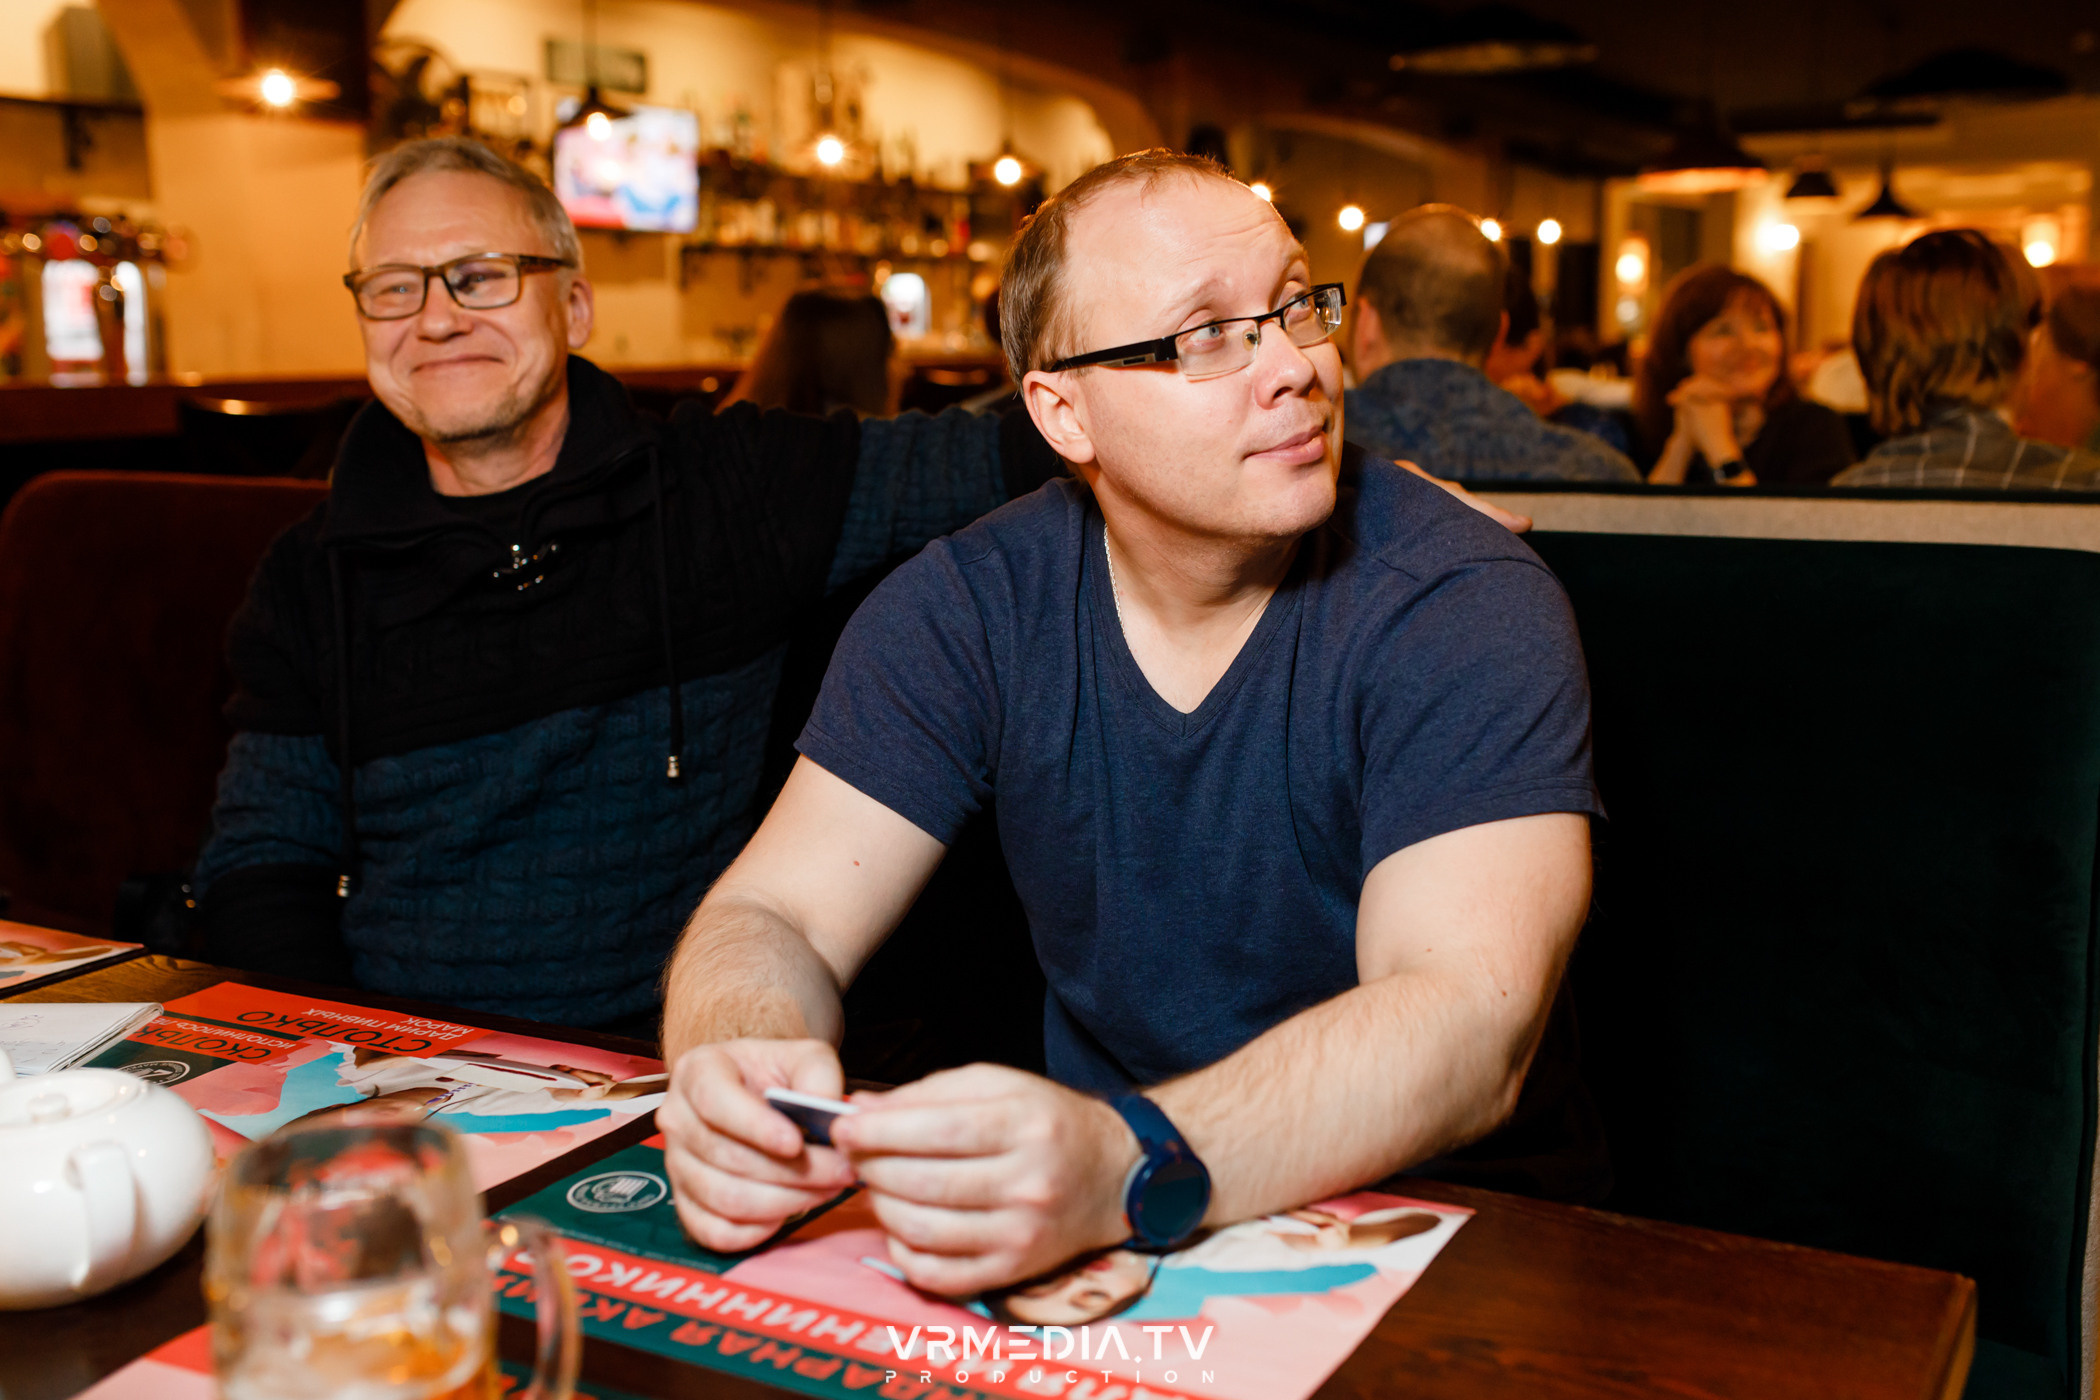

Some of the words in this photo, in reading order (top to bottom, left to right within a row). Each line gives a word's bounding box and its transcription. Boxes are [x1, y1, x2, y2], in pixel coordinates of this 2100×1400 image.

[301, 1009, 387, 1028] ПИВНЫХ
[401, 1018, 475, 1036] МАРОК
[177, 1021, 296, 1049] ИСПОЛНИЛОСЬ
[237, 1011, 432, 1052] СТОЛЬКО
[388, 1022, 463, 1041] ДАРИМ
